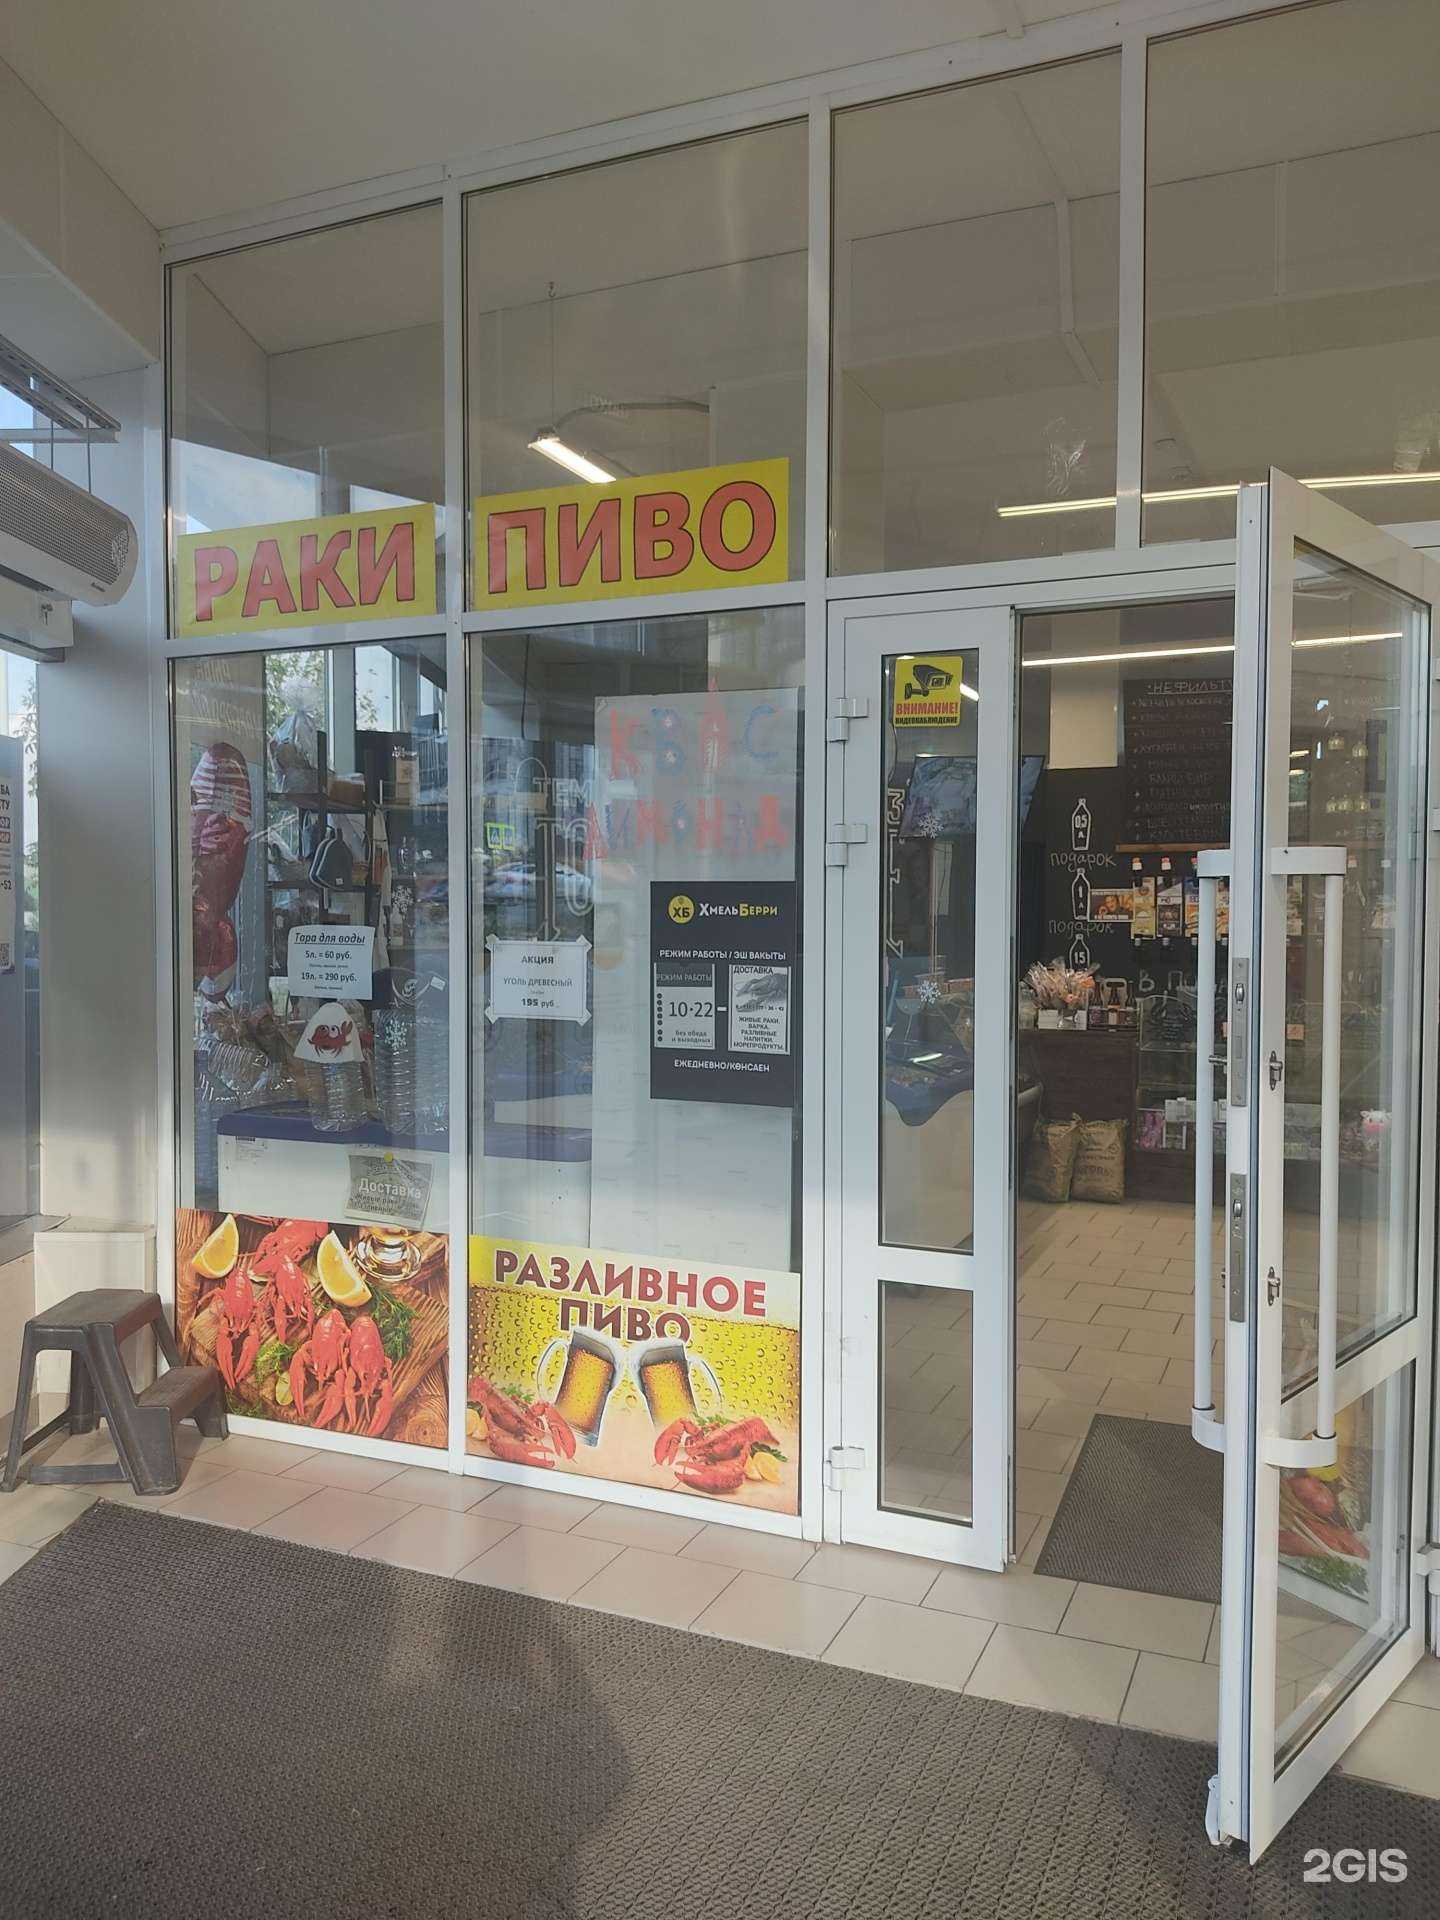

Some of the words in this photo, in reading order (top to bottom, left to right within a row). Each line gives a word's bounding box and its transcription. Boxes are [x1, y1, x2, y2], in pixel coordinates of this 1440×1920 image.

[488, 480, 776, 594] ПИВО
[194, 522, 416, 622] РАКИ
[896, 702, 958, 715] ВНИМАНИЕ!
[673, 907, 690, 918] ХБ
[295, 932, 317, 944] Тара
[318, 932, 336, 944] для
[338, 933, 366, 944] воды
[324, 950, 334, 959] 60
[336, 951, 352, 960] руб.
[521, 956, 554, 965] АКЦИЯ
[659, 950, 692, 958] РЕЖИМ
[693, 950, 728, 959] РАБОТЫ
[734, 951, 748, 959] ЭШ
[749, 952, 787, 960] ВАКЫТЫ
[733, 966, 774, 975] ДОСТАВКА
[504, 977, 527, 985] УГОЛЬ
[528, 978, 573, 987] ДРЕВЕСНЫЙ
[521, 998, 539, 1006] 195
[359, 1178, 421, 1198] Доставка
[495, 1249, 766, 1317] РАЗЛИВНОЕ
[560, 1298, 691, 1342] ПИВО
